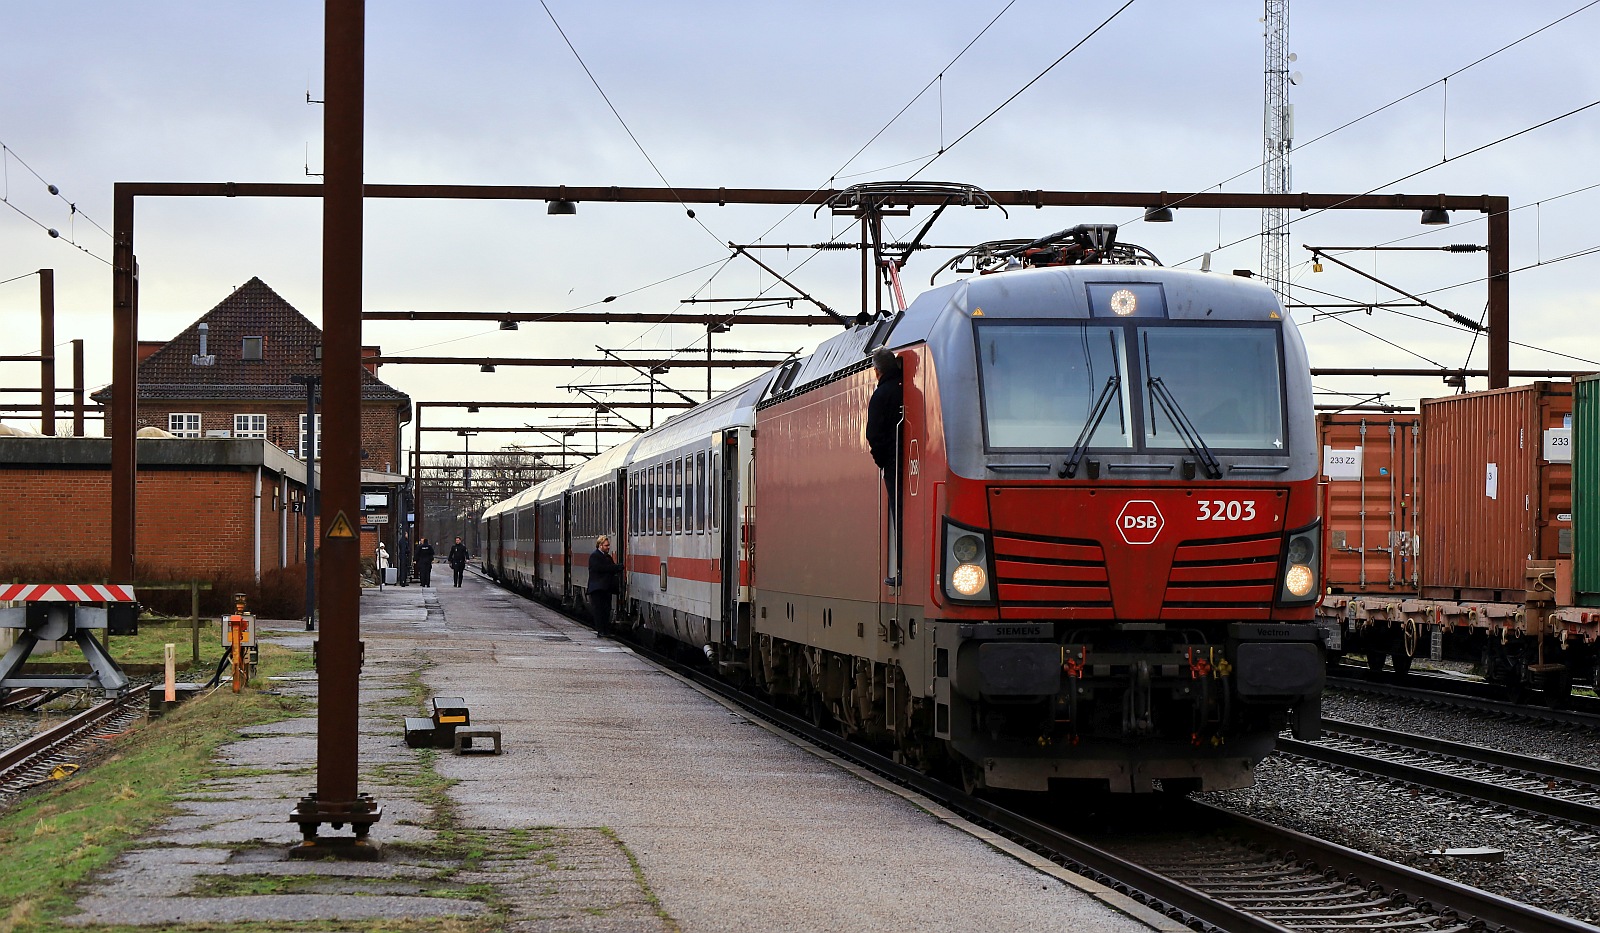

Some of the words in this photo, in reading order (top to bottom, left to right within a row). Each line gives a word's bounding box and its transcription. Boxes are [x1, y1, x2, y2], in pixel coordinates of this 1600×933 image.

[1552, 437, 1569, 446] 233
[1330, 456, 1344, 464] 233
[1345, 456, 1355, 465] Z2
[294, 504, 300, 512] 2
[1196, 500, 1256, 521] 3203
[1124, 515, 1158, 529] DSB
[996, 627, 1041, 636] SIEMENS
[1257, 628, 1290, 636] Vectron
